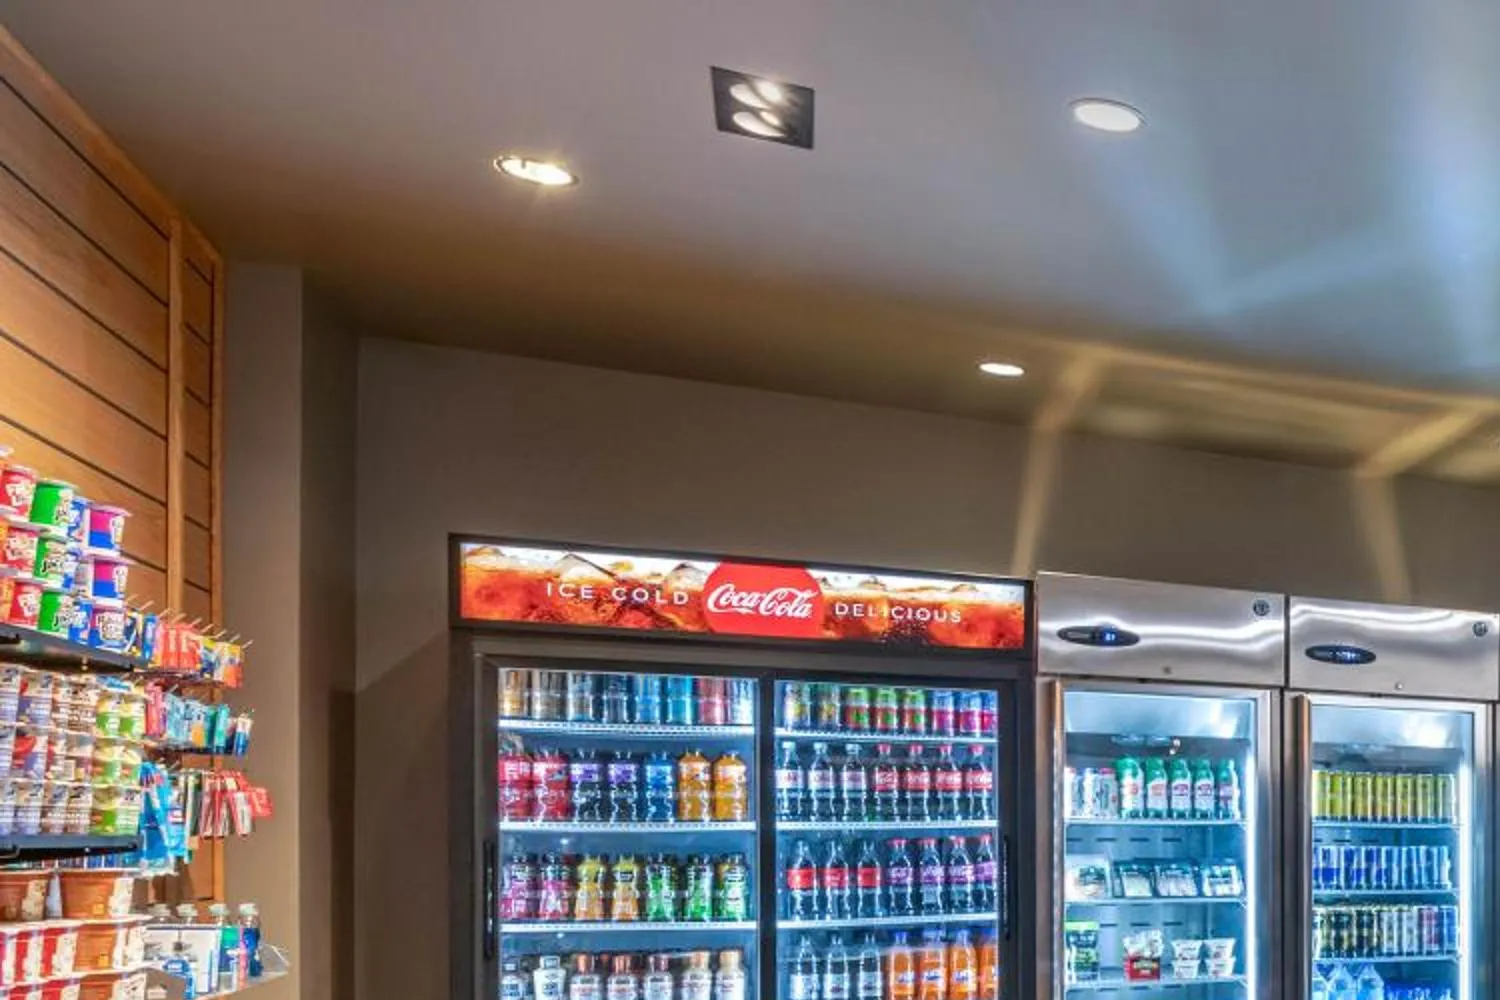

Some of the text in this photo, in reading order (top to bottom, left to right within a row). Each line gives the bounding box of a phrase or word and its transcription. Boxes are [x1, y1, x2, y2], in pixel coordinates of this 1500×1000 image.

[546, 583, 690, 606] ICE COLD
[707, 583, 819, 619] Coca-Cola
[834, 602, 962, 625] DELICIOUS
